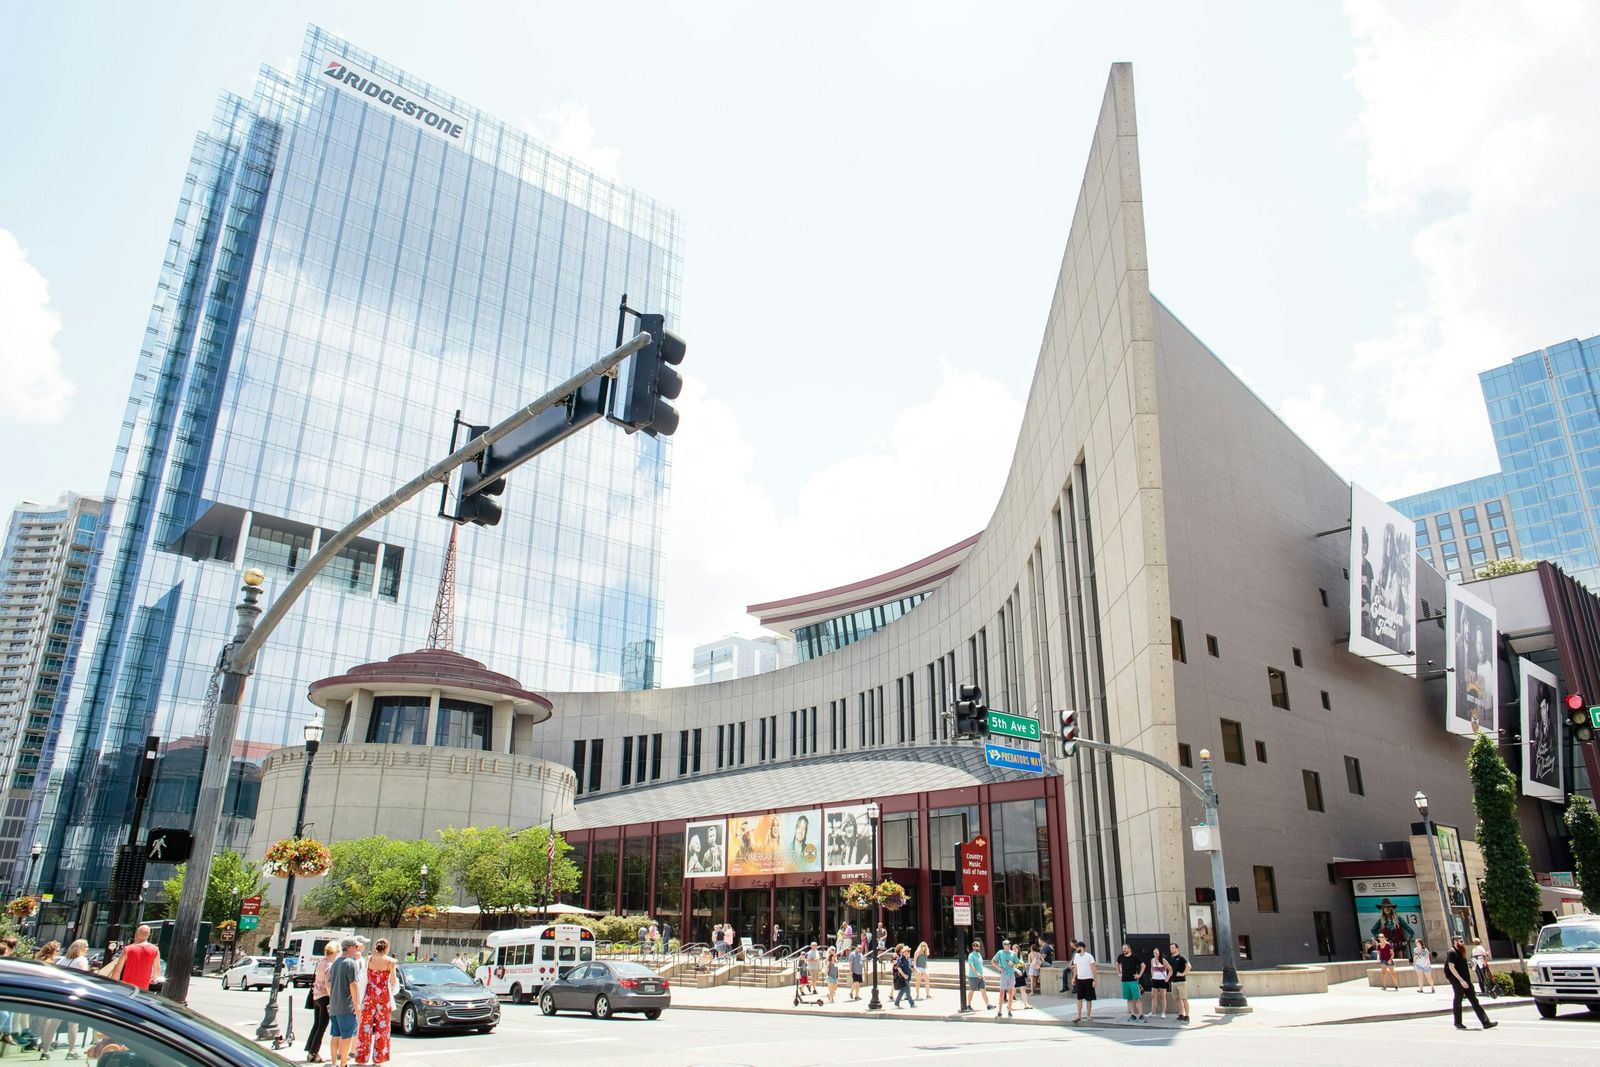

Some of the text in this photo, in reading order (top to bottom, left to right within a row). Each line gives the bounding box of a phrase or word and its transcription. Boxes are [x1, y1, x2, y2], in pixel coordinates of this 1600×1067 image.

[324, 61, 463, 138] BRIDGESTONE
[992, 717, 1036, 735] 5th Ave S
[1001, 752, 1041, 767] PREDATORS WAY
[966, 852, 983, 861] Country
[1406, 914, 1418, 925] 13
